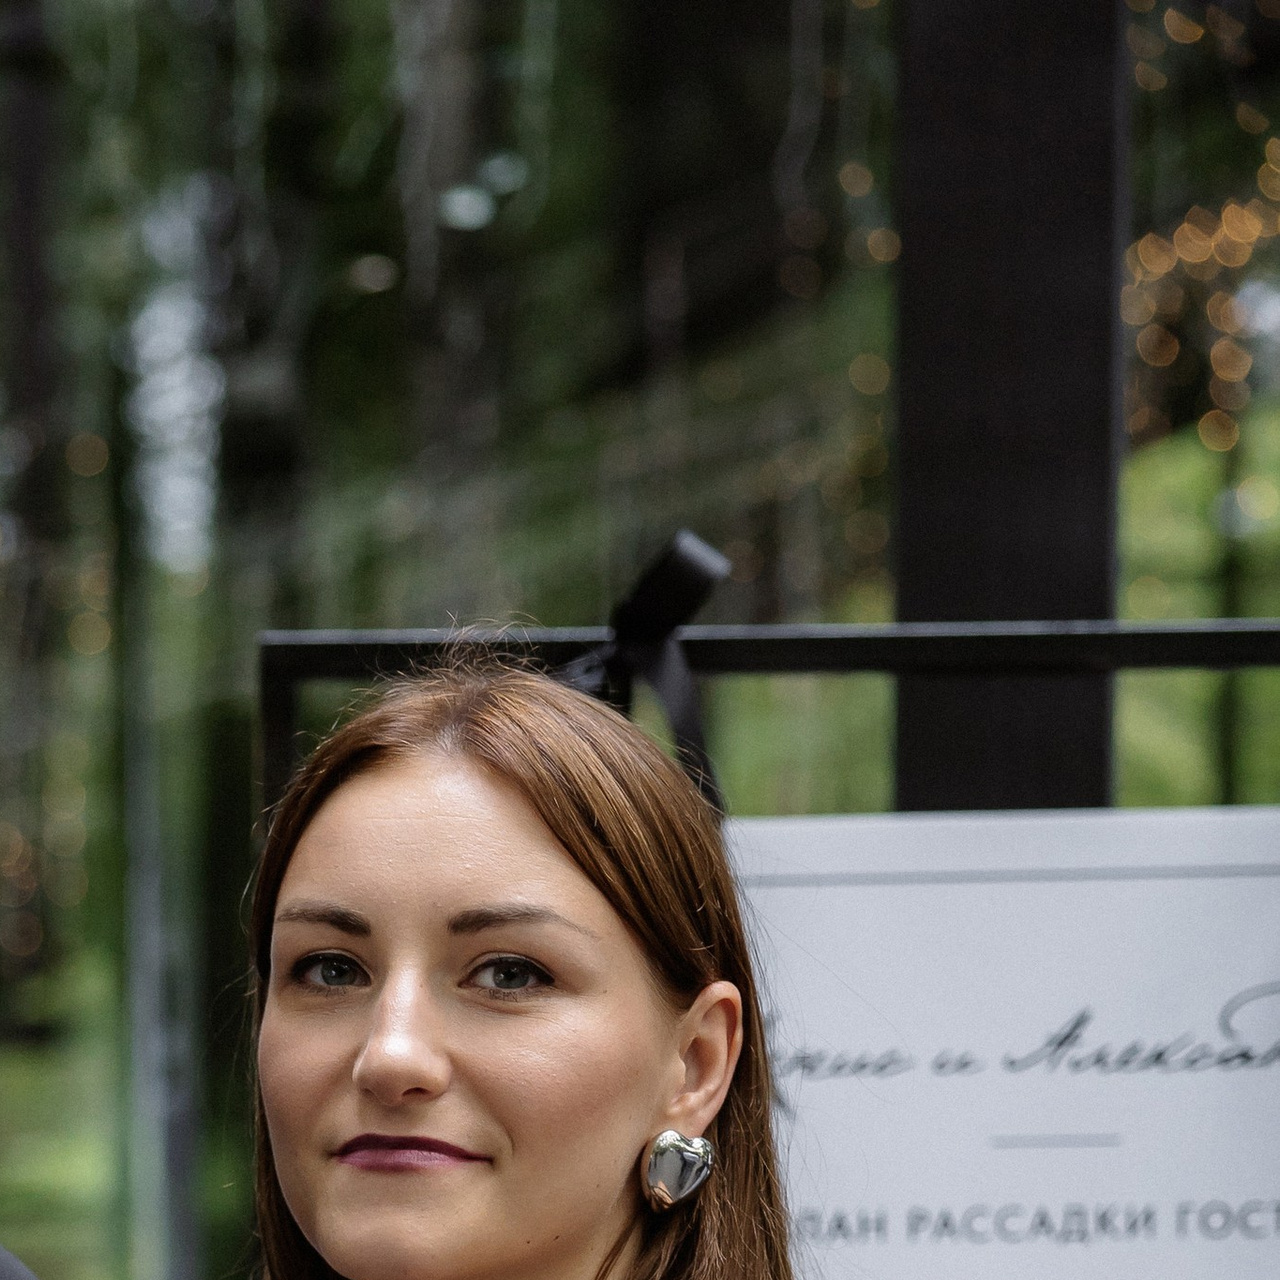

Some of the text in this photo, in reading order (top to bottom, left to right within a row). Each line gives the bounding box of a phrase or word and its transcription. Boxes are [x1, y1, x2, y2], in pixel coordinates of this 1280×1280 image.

[794, 1199, 1280, 1246] ЛАН РАССАДКИ ГОС
